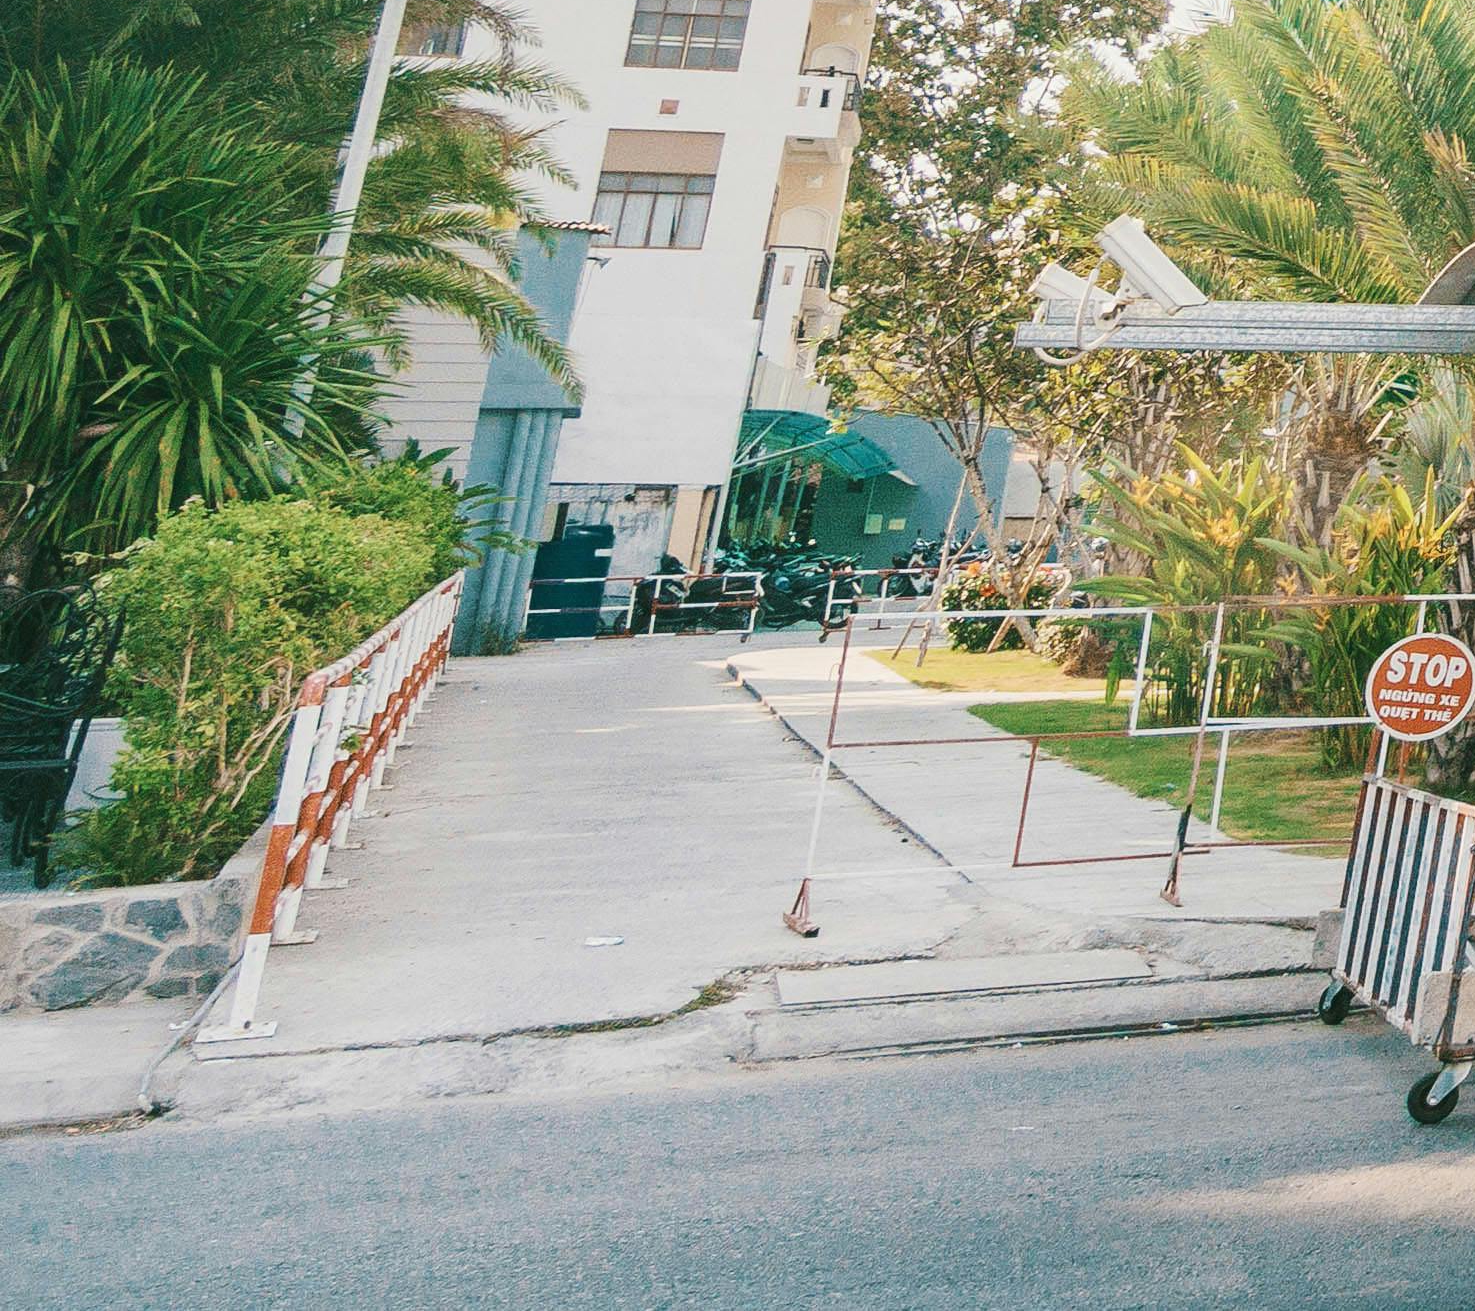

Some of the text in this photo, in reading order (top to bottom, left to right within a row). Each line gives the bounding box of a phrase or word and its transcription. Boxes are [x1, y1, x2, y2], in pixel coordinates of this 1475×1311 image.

[1386, 650, 1468, 688] STOP
[1438, 694, 1461, 707] XE
[1379, 704, 1421, 721] QUẸT
